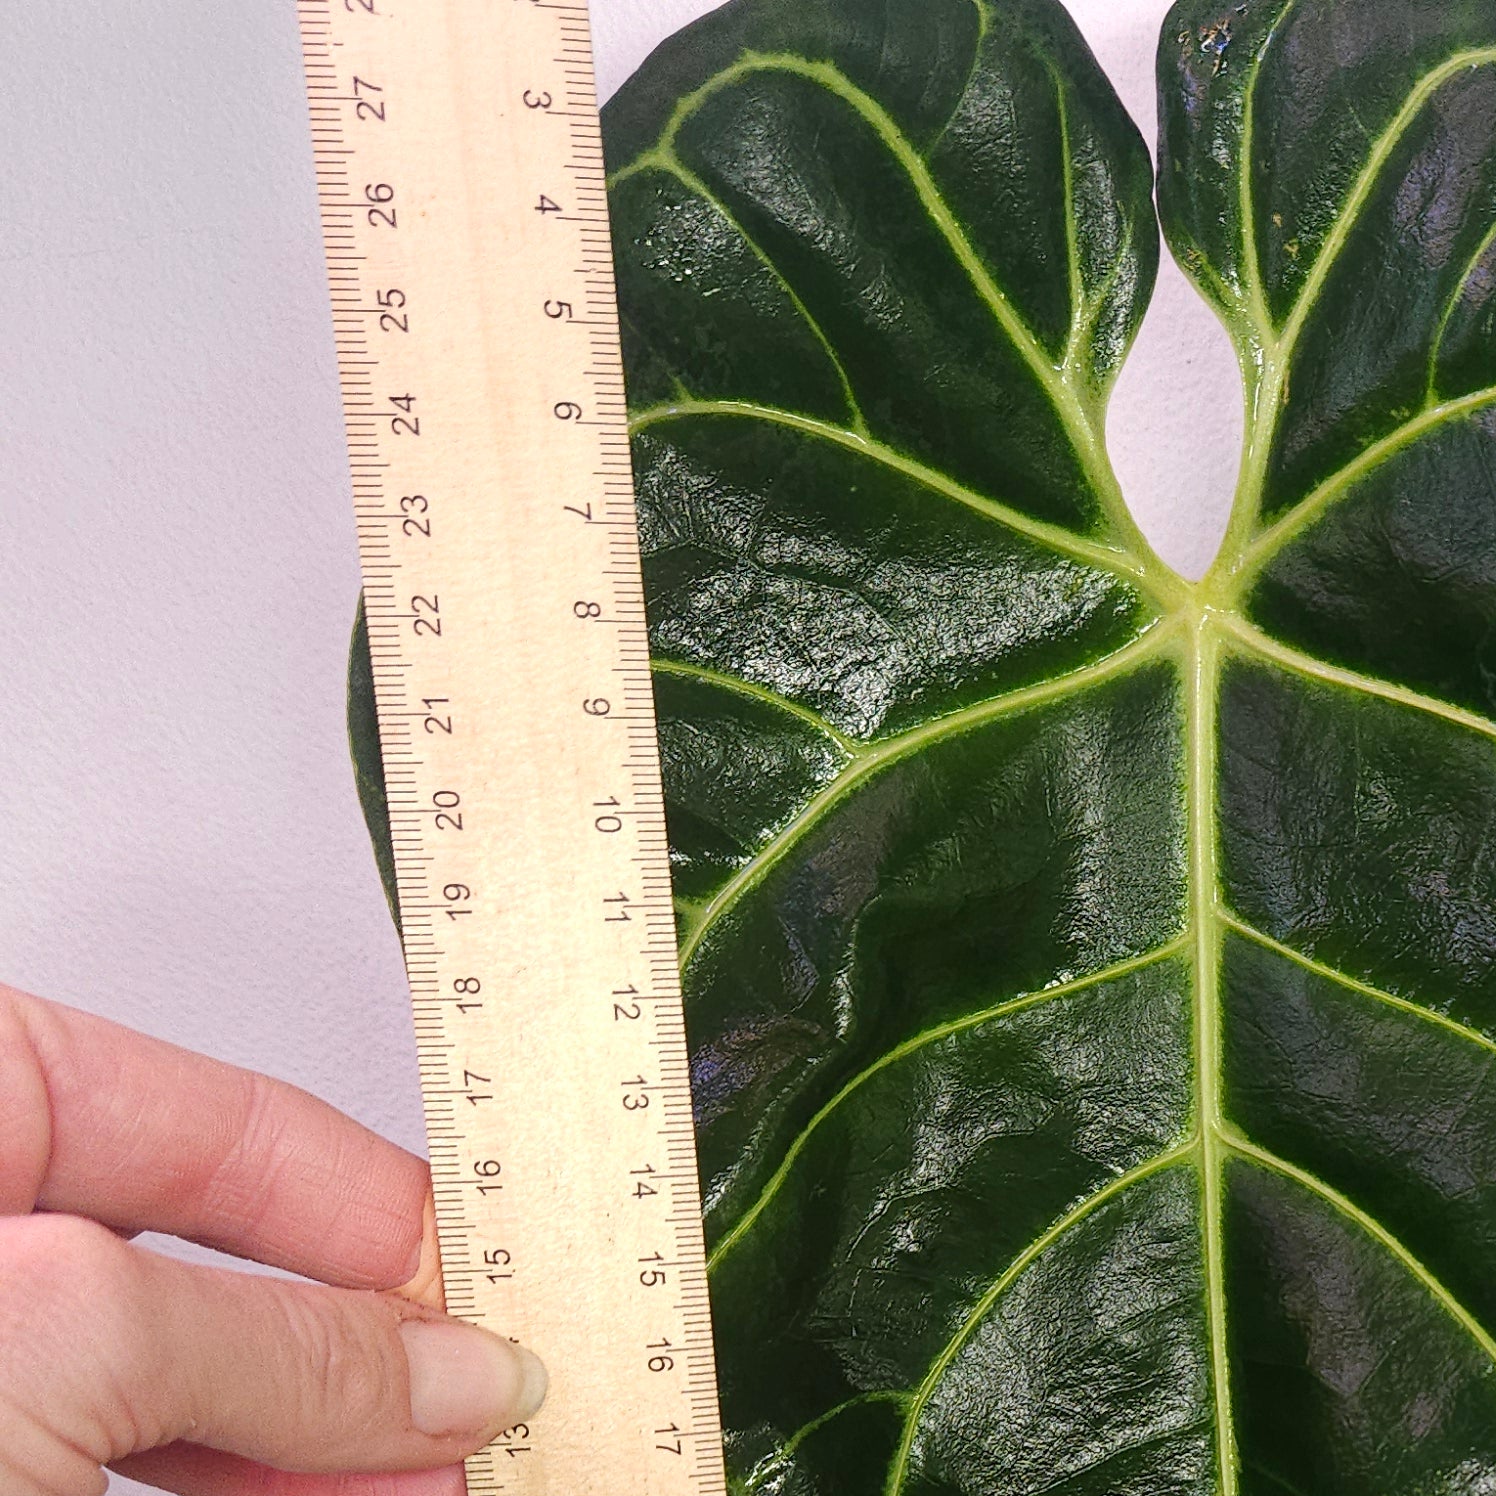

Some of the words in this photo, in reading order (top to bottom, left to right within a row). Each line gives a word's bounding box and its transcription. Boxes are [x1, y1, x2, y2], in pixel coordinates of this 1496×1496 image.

[352, 75, 386, 122] 27
[522, 89, 552, 110] 3
[365, 183, 398, 229] 26
[534, 193, 564, 216] 4
[376, 288, 409, 334] 25
[543, 299, 573, 320] 5
[387, 392, 420, 437] 24
[553, 401, 583, 421] 6
[399, 494, 432, 538] 23
[562, 501, 593, 521] 7
[410, 594, 442, 637] 22
[572, 600, 602, 620] 8
[421, 697, 453, 735] 21
[582, 697, 611, 717] 9
[432, 790, 464, 832] 20
[592, 795, 623, 833] 10
[442, 882, 473, 921] 19
[602, 891, 633, 925] 11
[452, 977, 483, 1015] 18
[611, 983, 641, 1022] 12
[463, 1069, 494, 1107] 17
[620, 1074, 650, 1111] 13
[473, 1159, 503, 1197] 16
[629, 1163, 659, 1200] 14
[483, 1248, 513, 1285] 15
[637, 1250, 667, 1287] 15
[646, 1336, 675, 1373] 16
[502, 1422, 532, 1458] 13
[653, 1421, 682, 1457] 17
